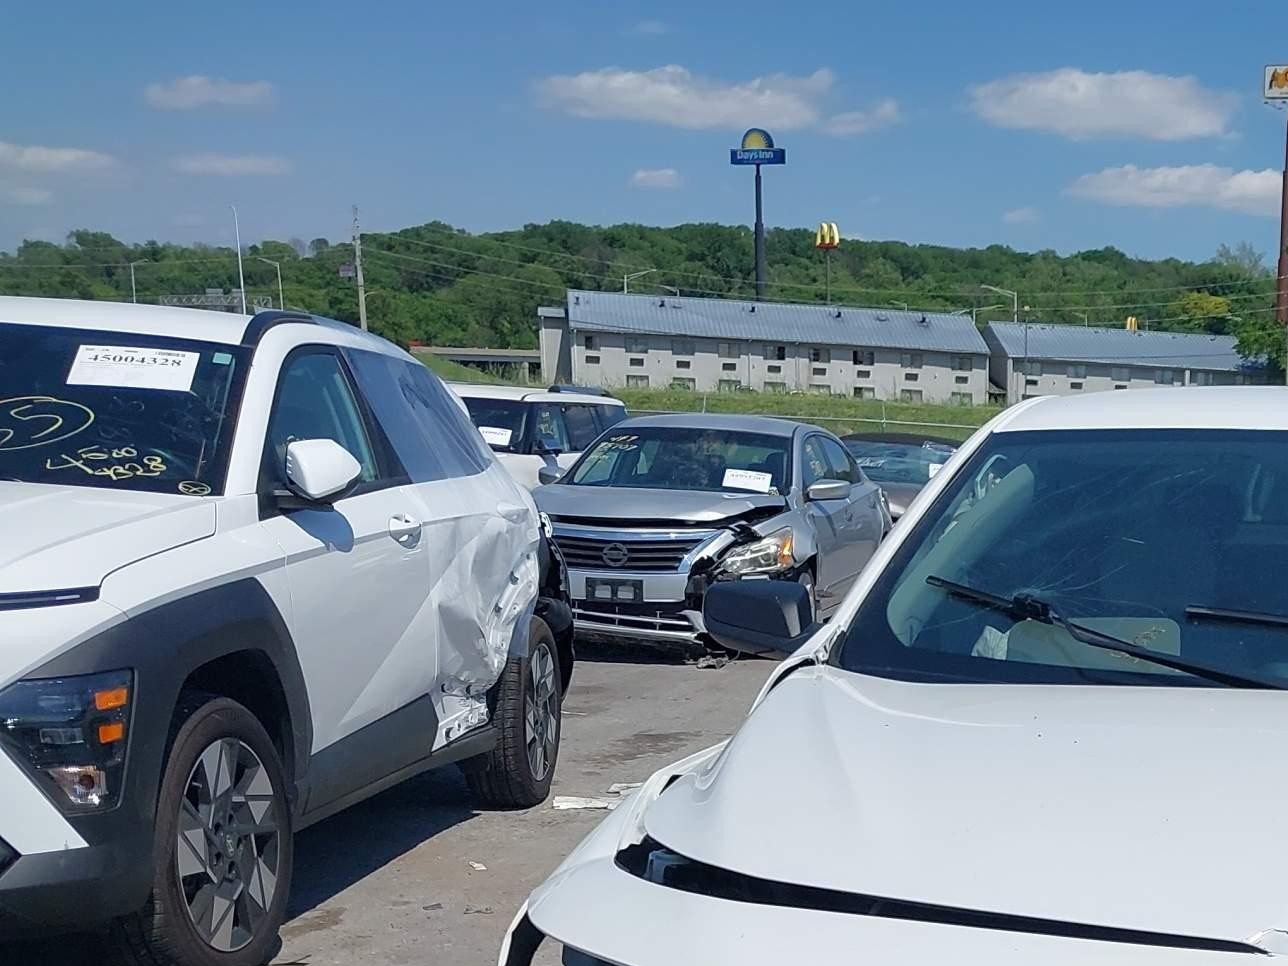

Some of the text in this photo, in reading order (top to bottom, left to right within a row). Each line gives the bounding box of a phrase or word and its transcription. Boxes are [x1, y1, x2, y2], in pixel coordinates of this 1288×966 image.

[736, 149, 774, 161] Days Inn
[87, 352, 183, 367] 45004328
